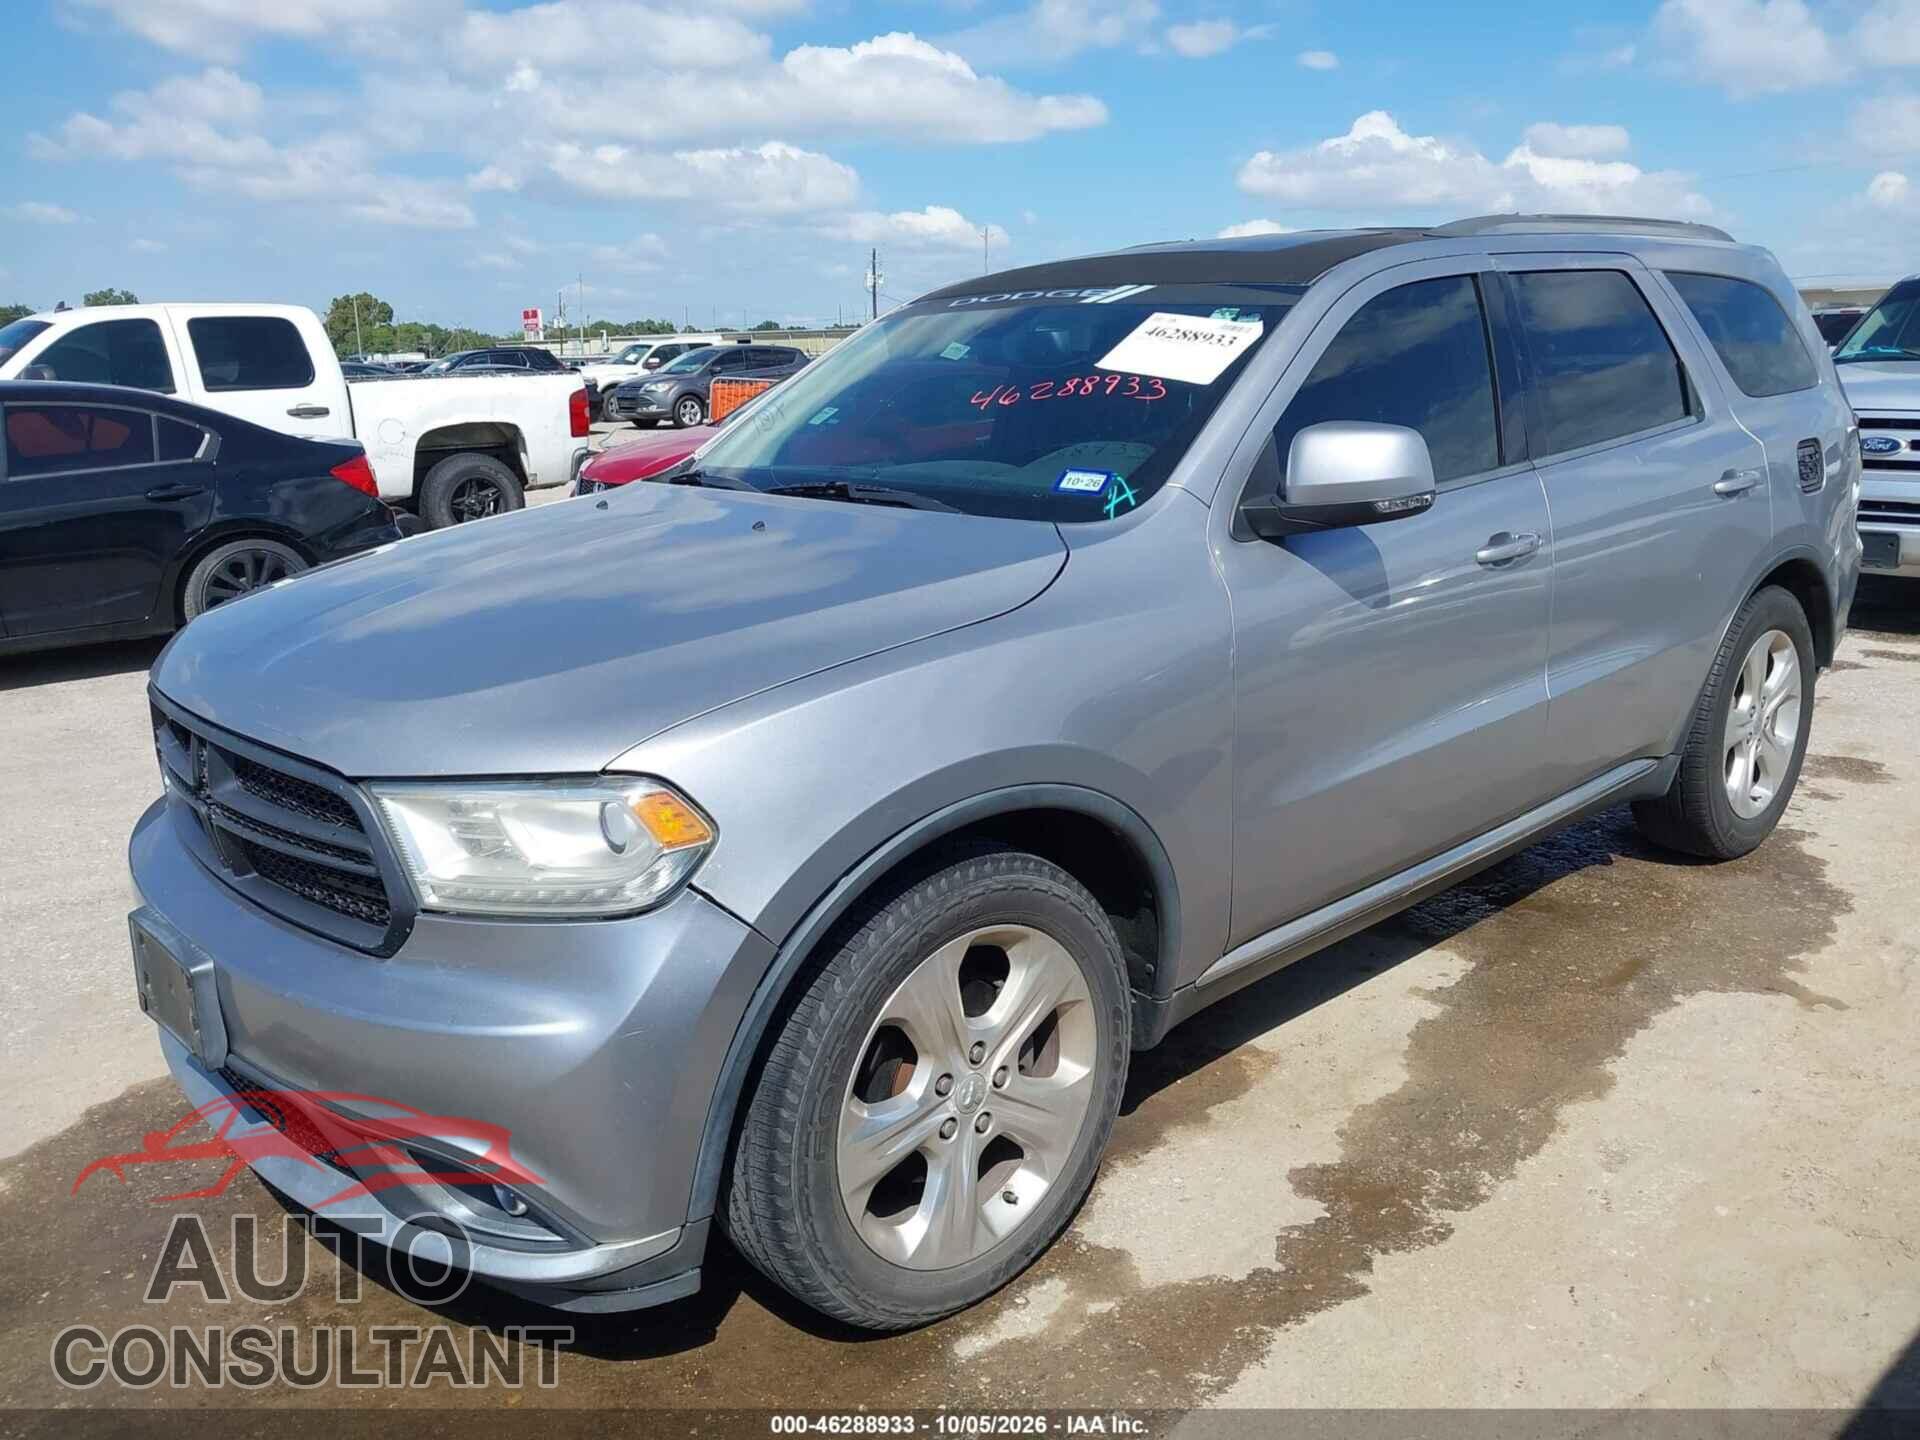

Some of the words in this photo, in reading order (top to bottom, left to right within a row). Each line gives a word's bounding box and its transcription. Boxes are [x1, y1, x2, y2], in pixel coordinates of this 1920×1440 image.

[947, 285, 1110, 308] DODGE
[1145, 325, 1238, 348] 46288933
[970, 375, 1167, 410] 46288933
[1862, 439, 1894, 452] Ford
